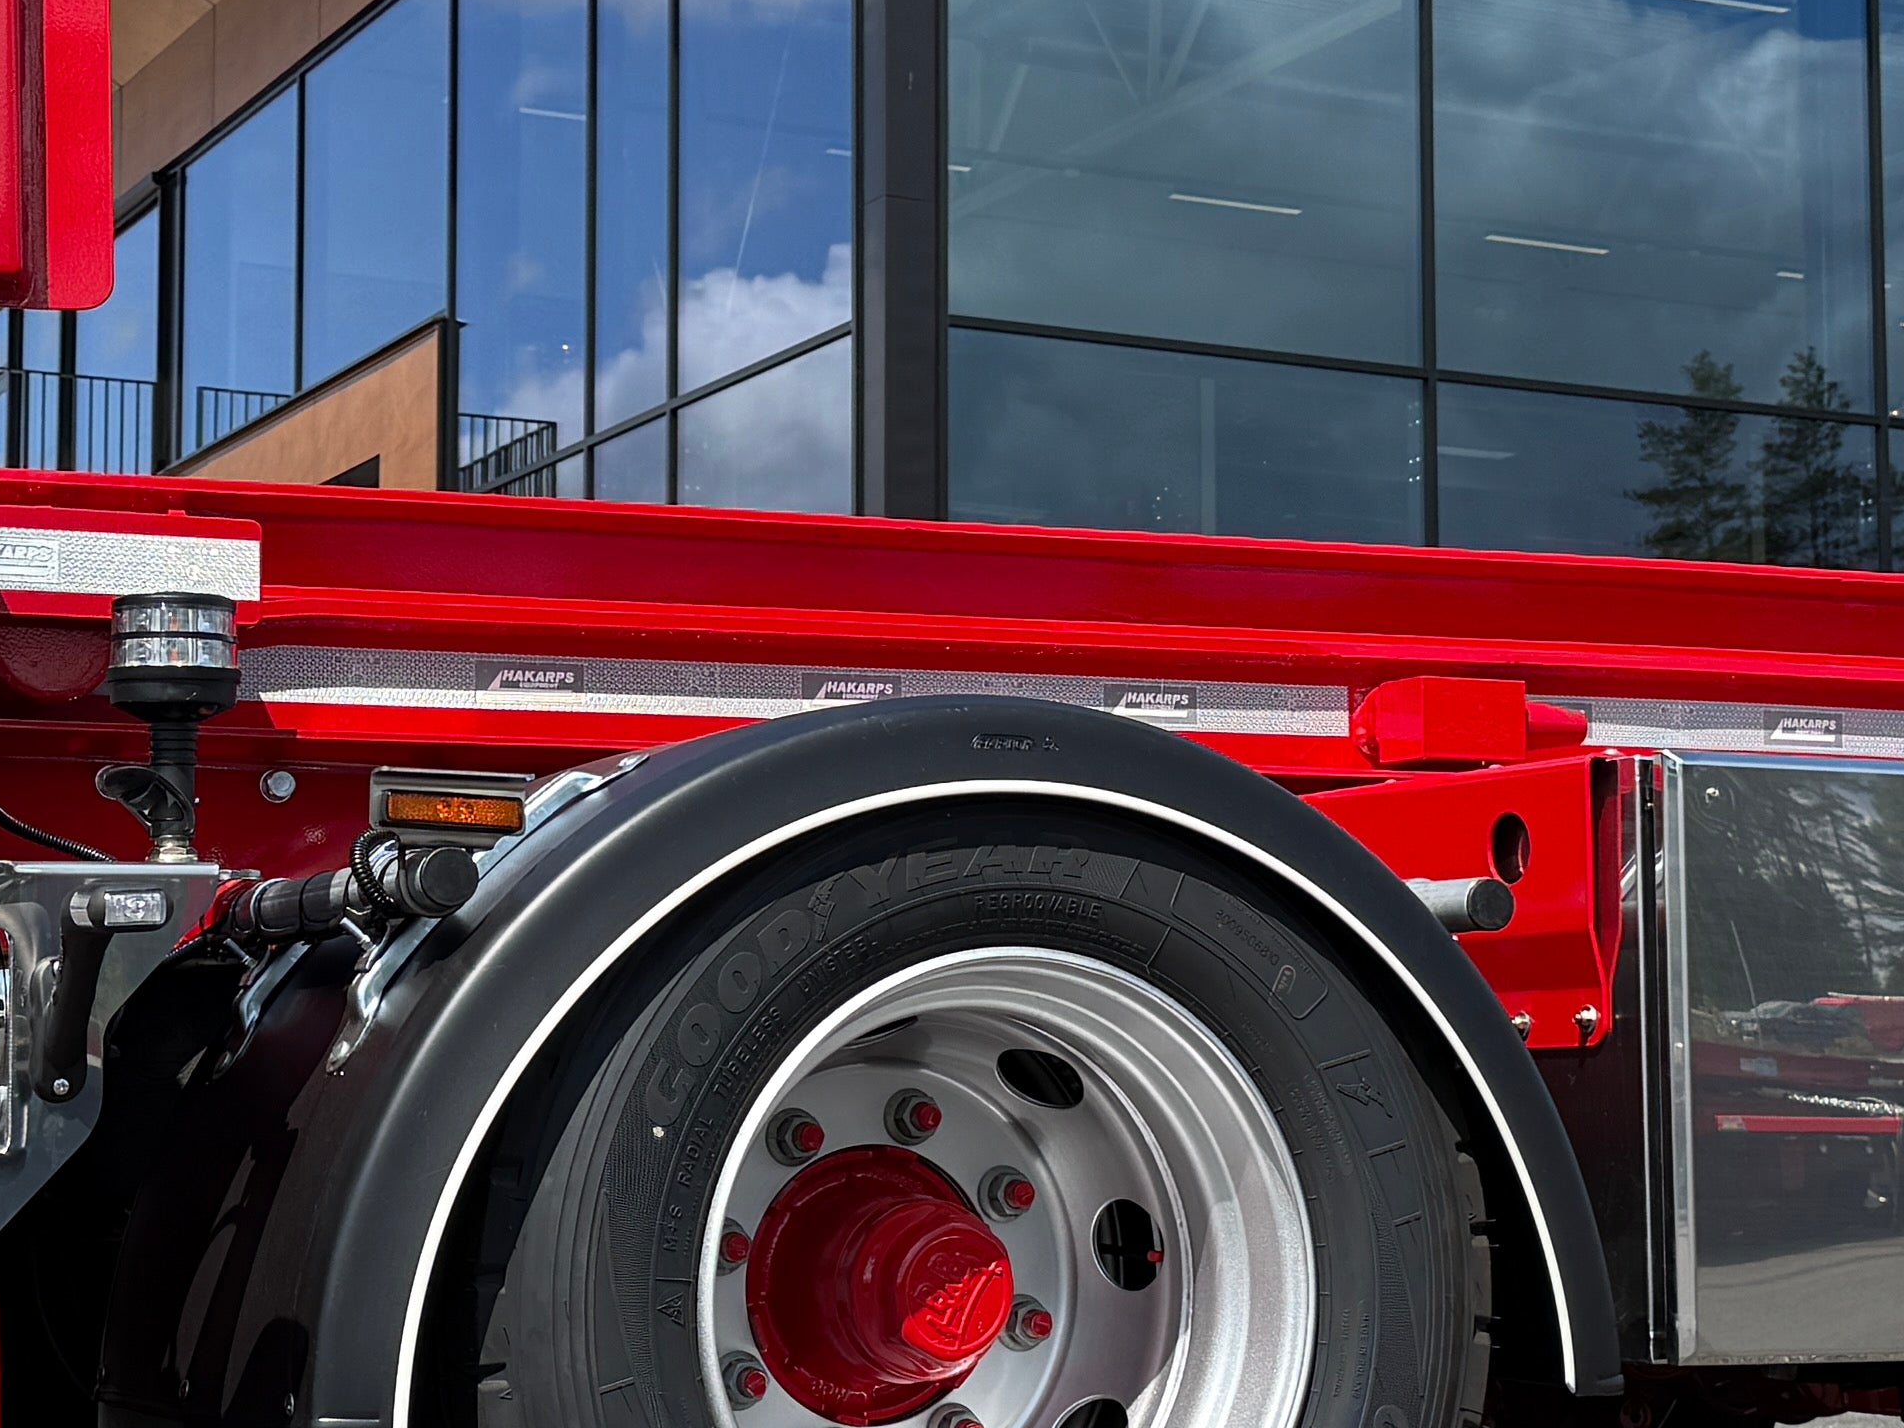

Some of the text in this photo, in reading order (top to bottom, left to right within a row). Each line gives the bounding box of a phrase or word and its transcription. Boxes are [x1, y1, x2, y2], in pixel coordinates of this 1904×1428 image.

[502, 670, 575, 684] HAKARPS
[827, 681, 894, 694] HAKARPS
[1127, 692, 1189, 705] HAKARPS
[1783, 717, 1837, 730] HAKARPS
[973, 892, 1103, 919] REGROOVABLE
[677, 1116, 714, 1187] RADIAL
[712, 1006, 784, 1099] TUBELESS
